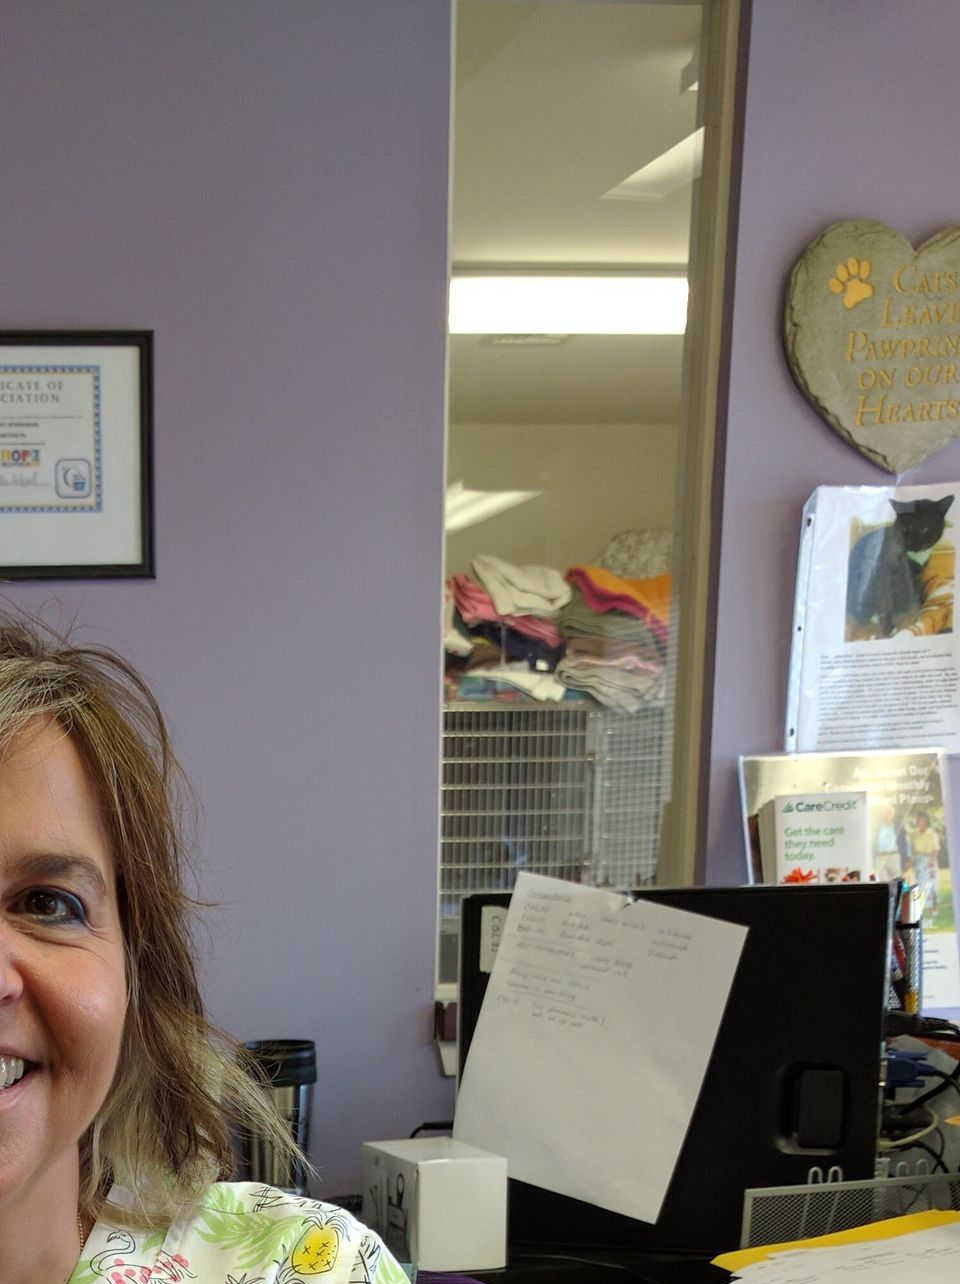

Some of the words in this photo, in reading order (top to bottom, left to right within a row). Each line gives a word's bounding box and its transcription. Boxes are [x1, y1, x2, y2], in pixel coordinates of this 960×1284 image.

[895, 264, 958, 294] CATS
[859, 367, 897, 388] ON
[904, 364, 959, 387] OUR
[46, 380, 64, 391] OF
[795, 801, 856, 812] CareCredit
[784, 827, 802, 837] Get
[805, 827, 821, 835] the
[823, 827, 845, 835] care
[784, 839, 807, 850] they
[809, 838, 834, 847] need
